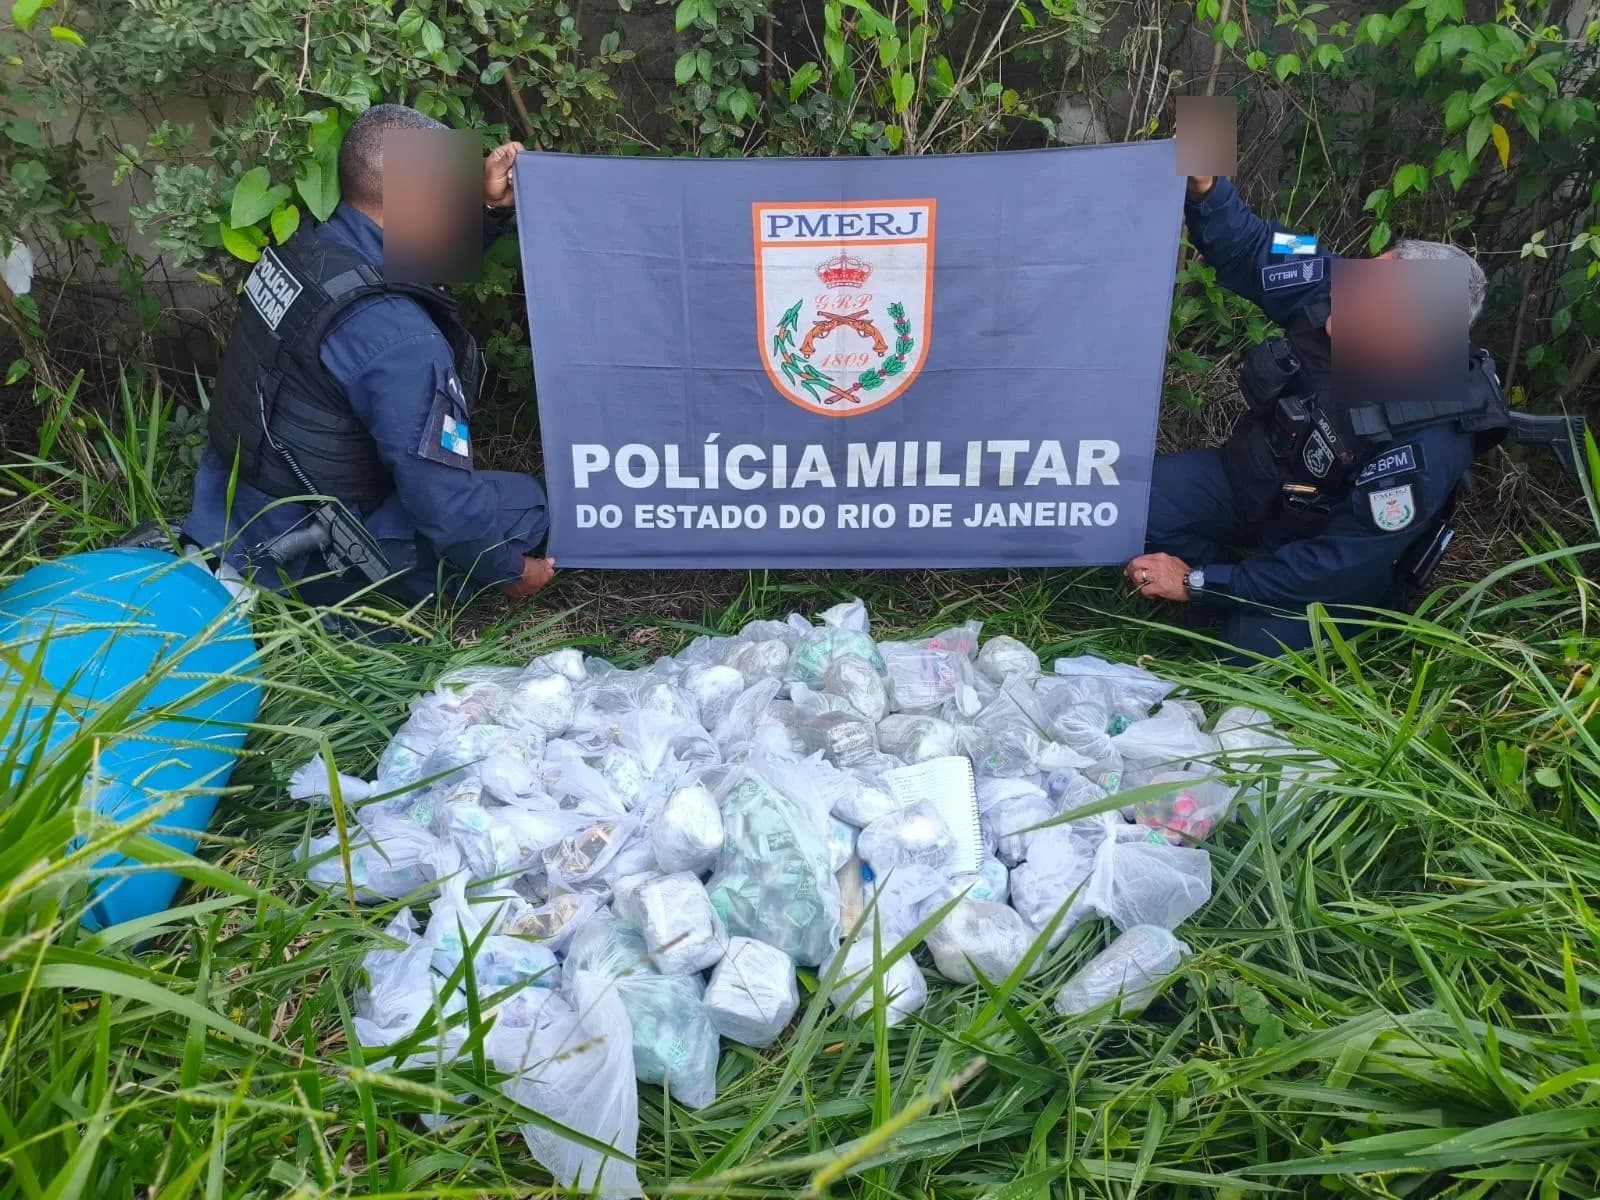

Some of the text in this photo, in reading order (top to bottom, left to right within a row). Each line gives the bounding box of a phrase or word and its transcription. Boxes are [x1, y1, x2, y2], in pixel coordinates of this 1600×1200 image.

[766, 212, 923, 238] PMERJ
[820, 352, 870, 368] 1809
[571, 432, 1121, 490] POLÍCIA MILITAR
[1378, 451, 1408, 472] BPM
[576, 502, 1119, 530] DO ESTADO DO RIO DE JANEIRO
